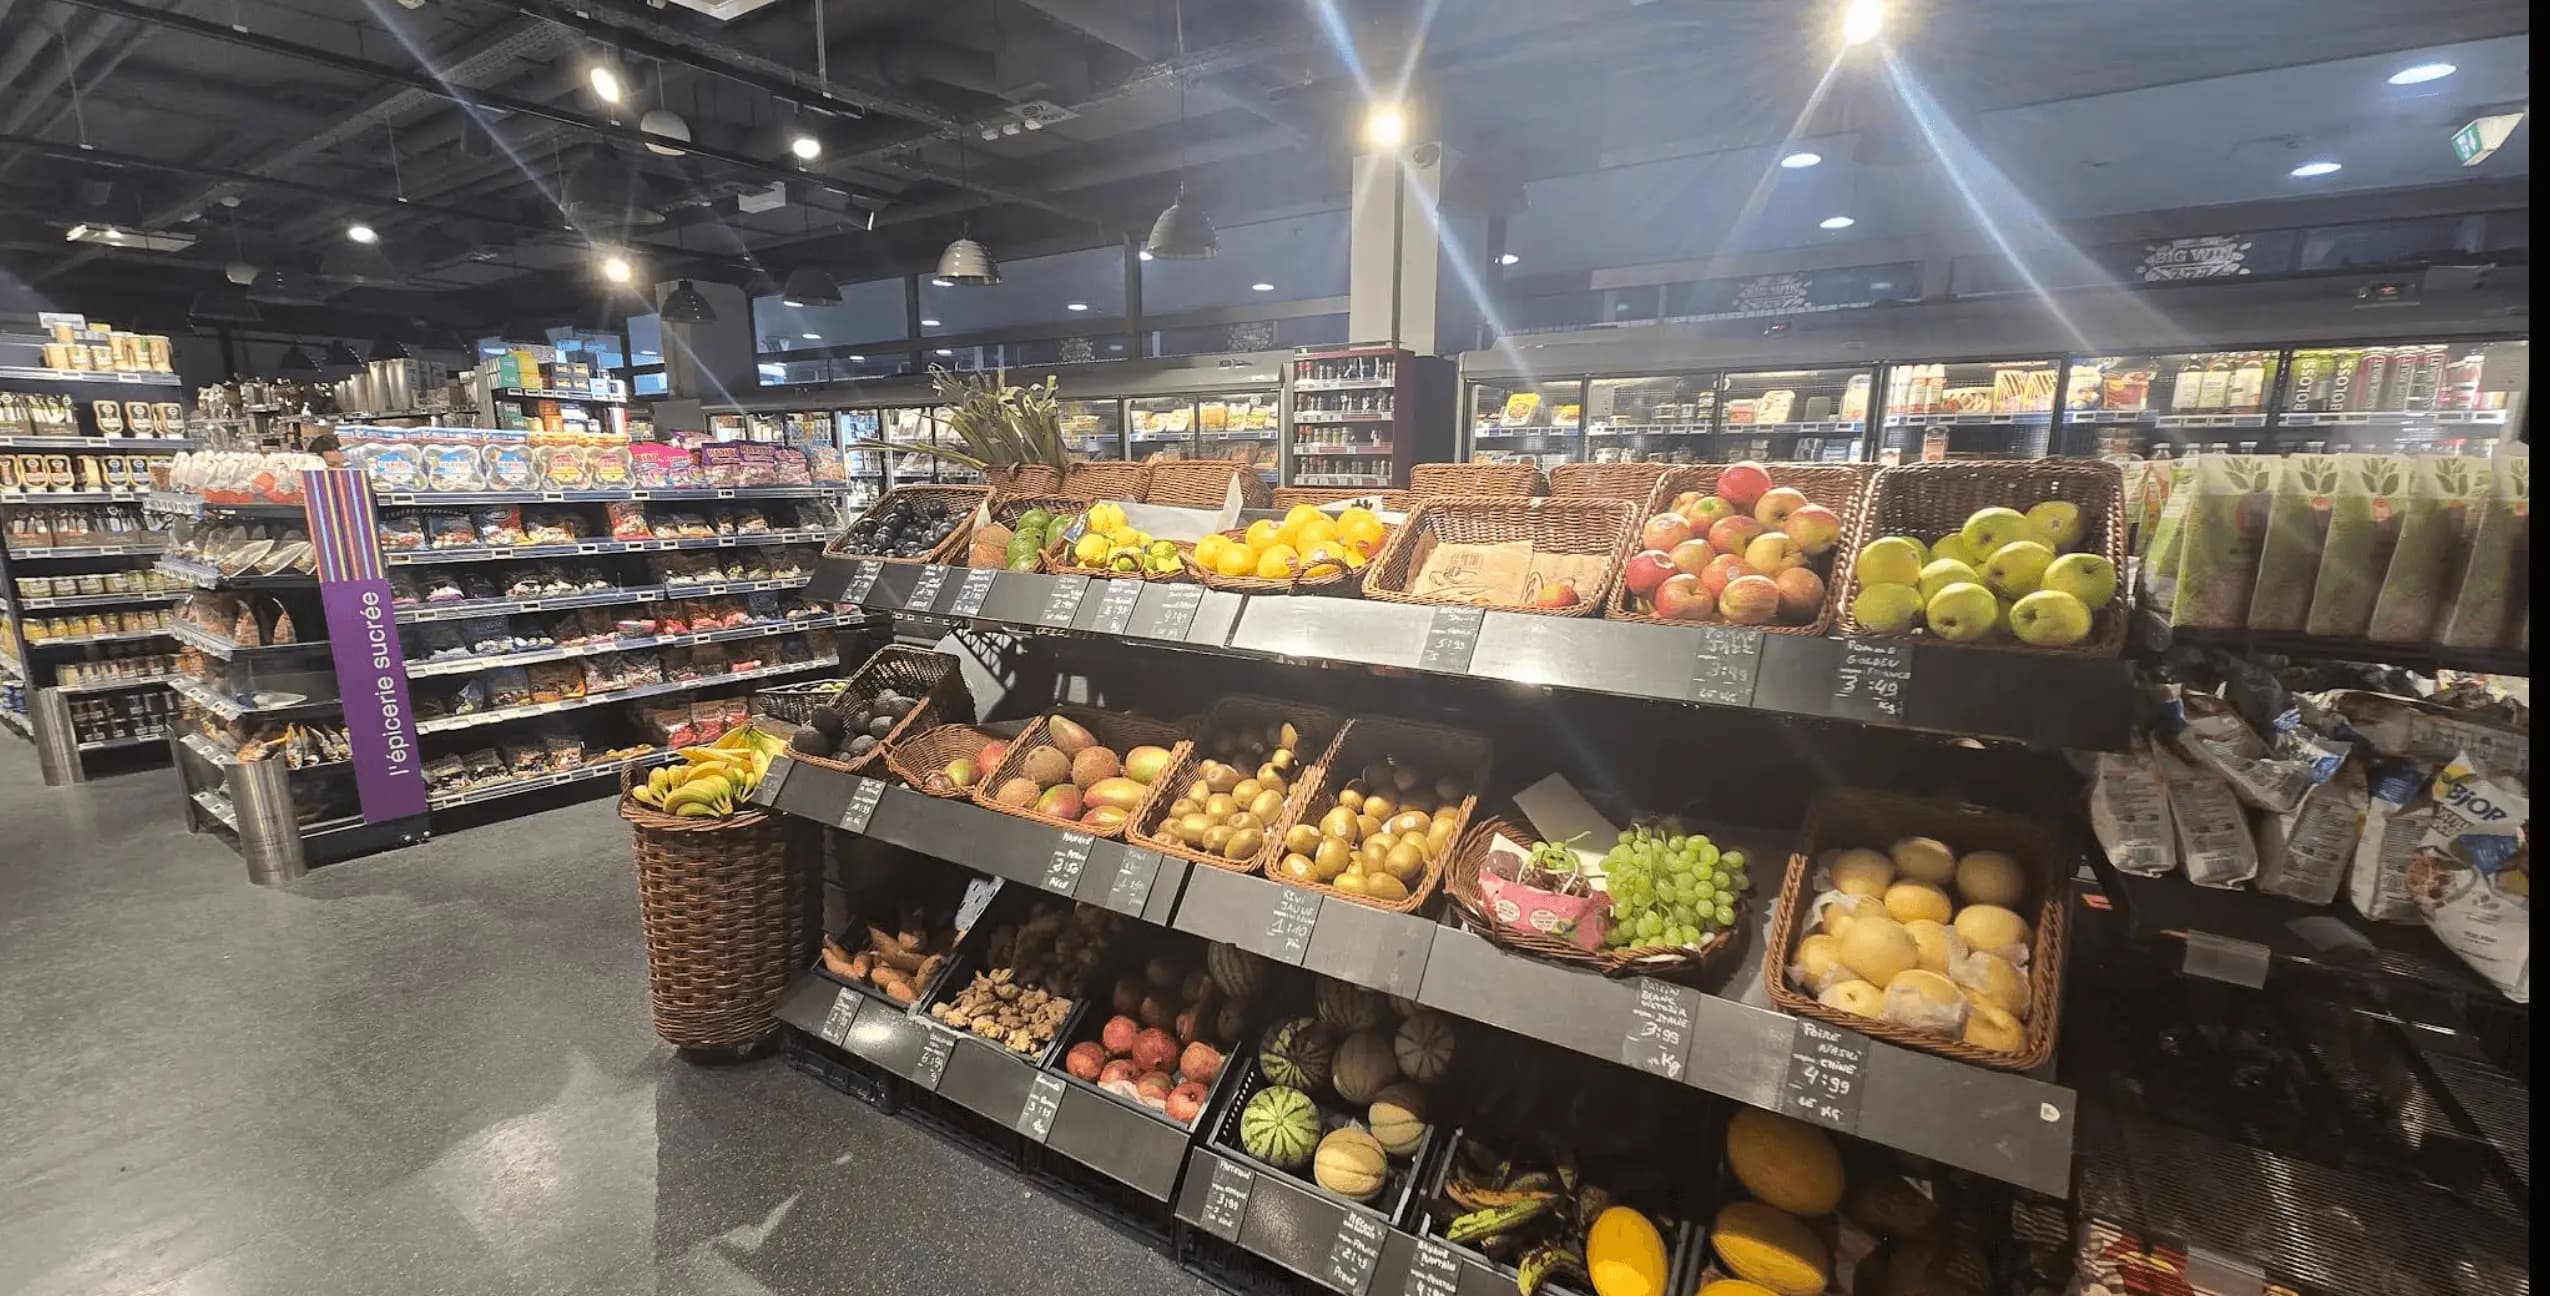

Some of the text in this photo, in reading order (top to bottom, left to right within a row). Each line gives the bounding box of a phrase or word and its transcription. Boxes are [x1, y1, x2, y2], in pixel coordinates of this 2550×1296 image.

[2154, 243, 2237, 263] BIG WIN
[2294, 359, 2318, 411] BOLOSS
[2330, 360, 2354, 411] BOLOSS
[360, 591, 410, 776] l'épicerie sucrée
[1804, 1066, 1851, 1095] 4:99
